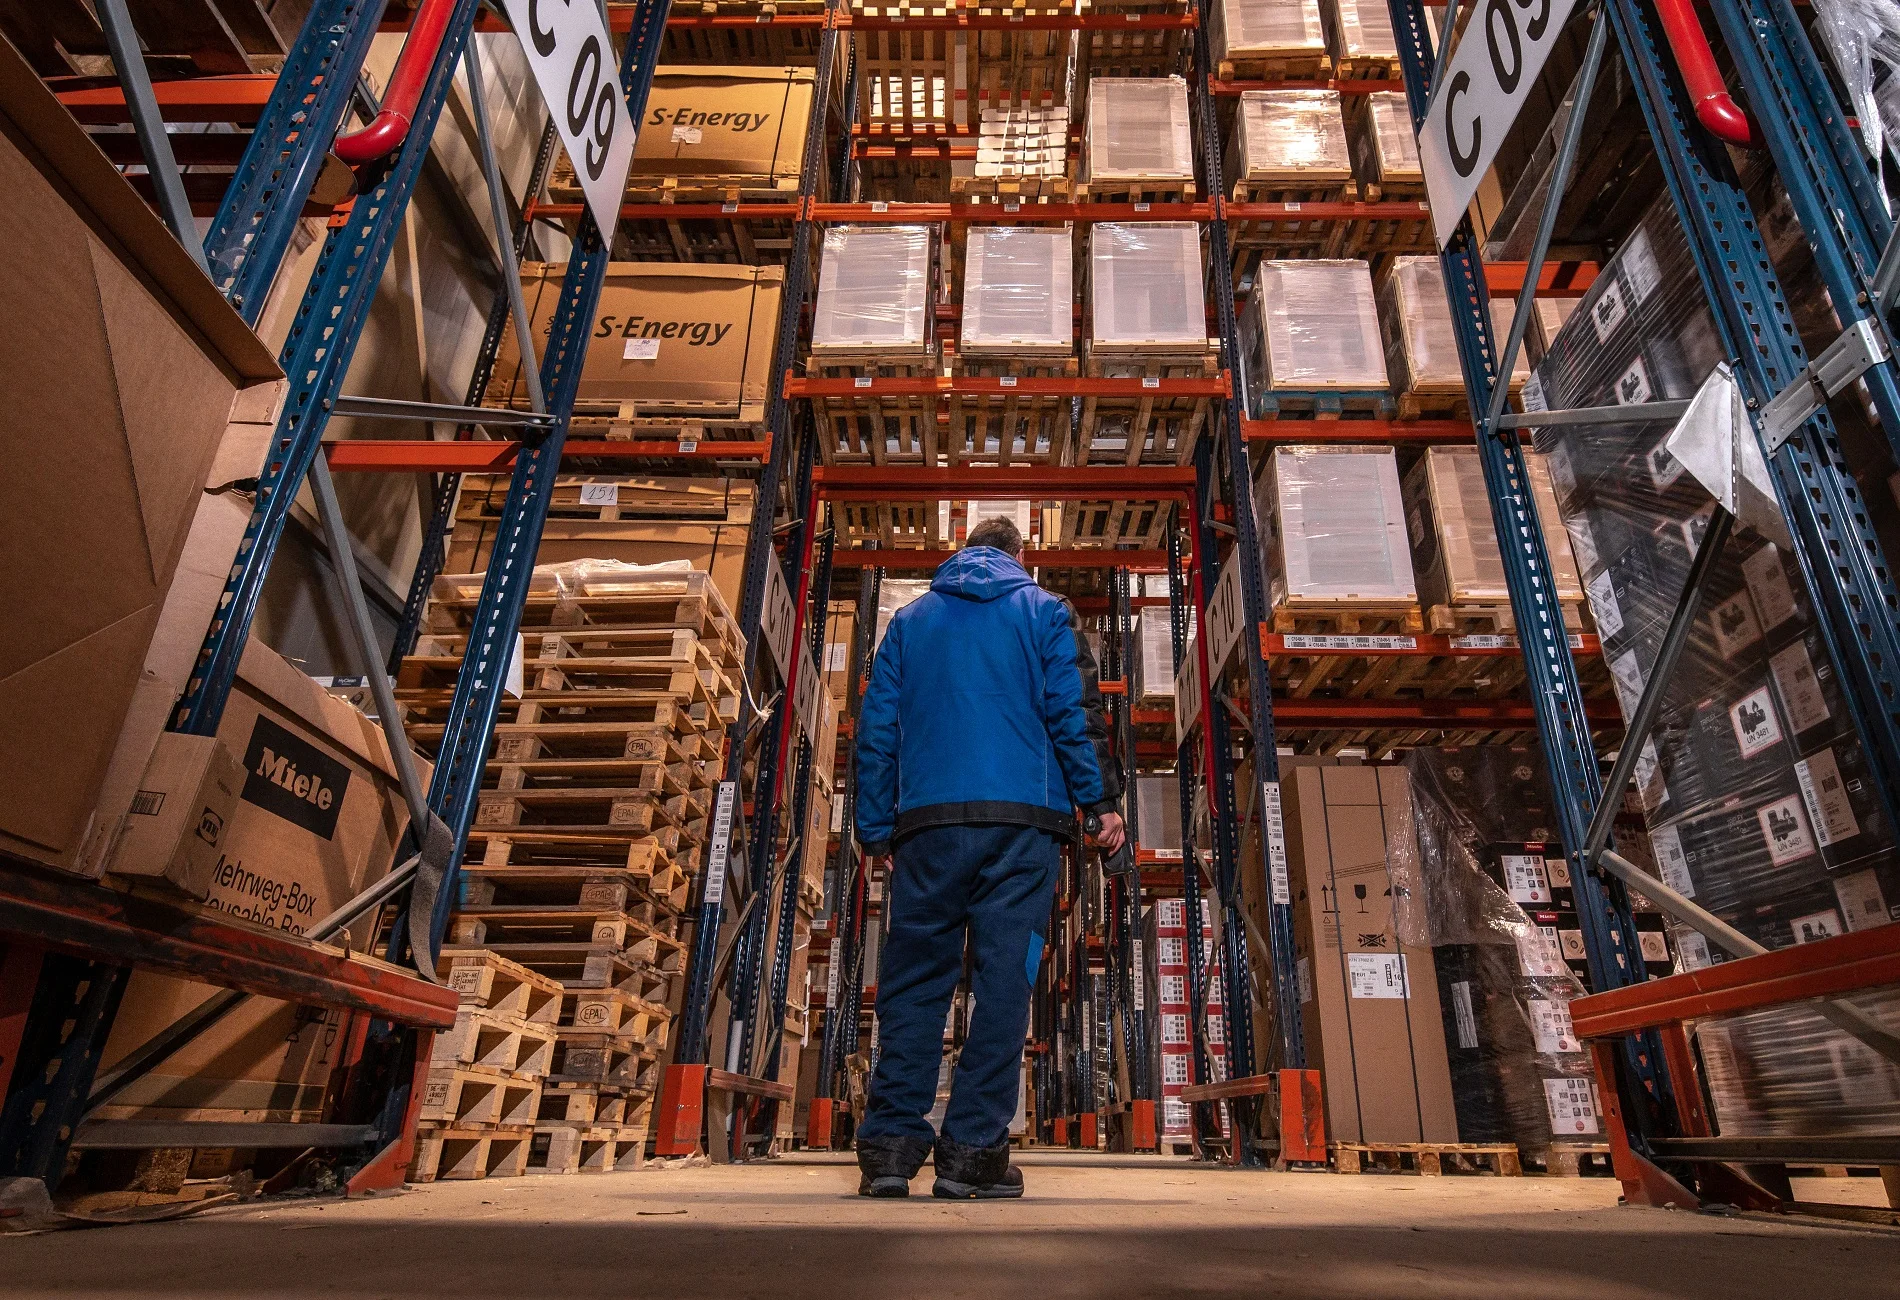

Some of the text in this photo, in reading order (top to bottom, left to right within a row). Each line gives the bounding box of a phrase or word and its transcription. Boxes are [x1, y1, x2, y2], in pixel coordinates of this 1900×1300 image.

[529, 0, 616, 181] C 09
[648, 107, 770, 132] S-Energy
[1446, 71, 1481, 177] C
[594, 315, 732, 346] S-Energy
[588, 486, 615, 500] 151
[769, 572, 790, 664] C 10
[1211, 573, 1235, 665] C 10
[801, 654, 815, 727] C 11
[1178, 655, 1197, 729] C 11
[631, 742, 648, 751] EPAL
[1747, 727, 1770, 744] UN 3481
[256, 746, 332, 810] Miele
[1777, 842, 1787, 851] UN
[584, 1008, 606, 1020] EPAL
